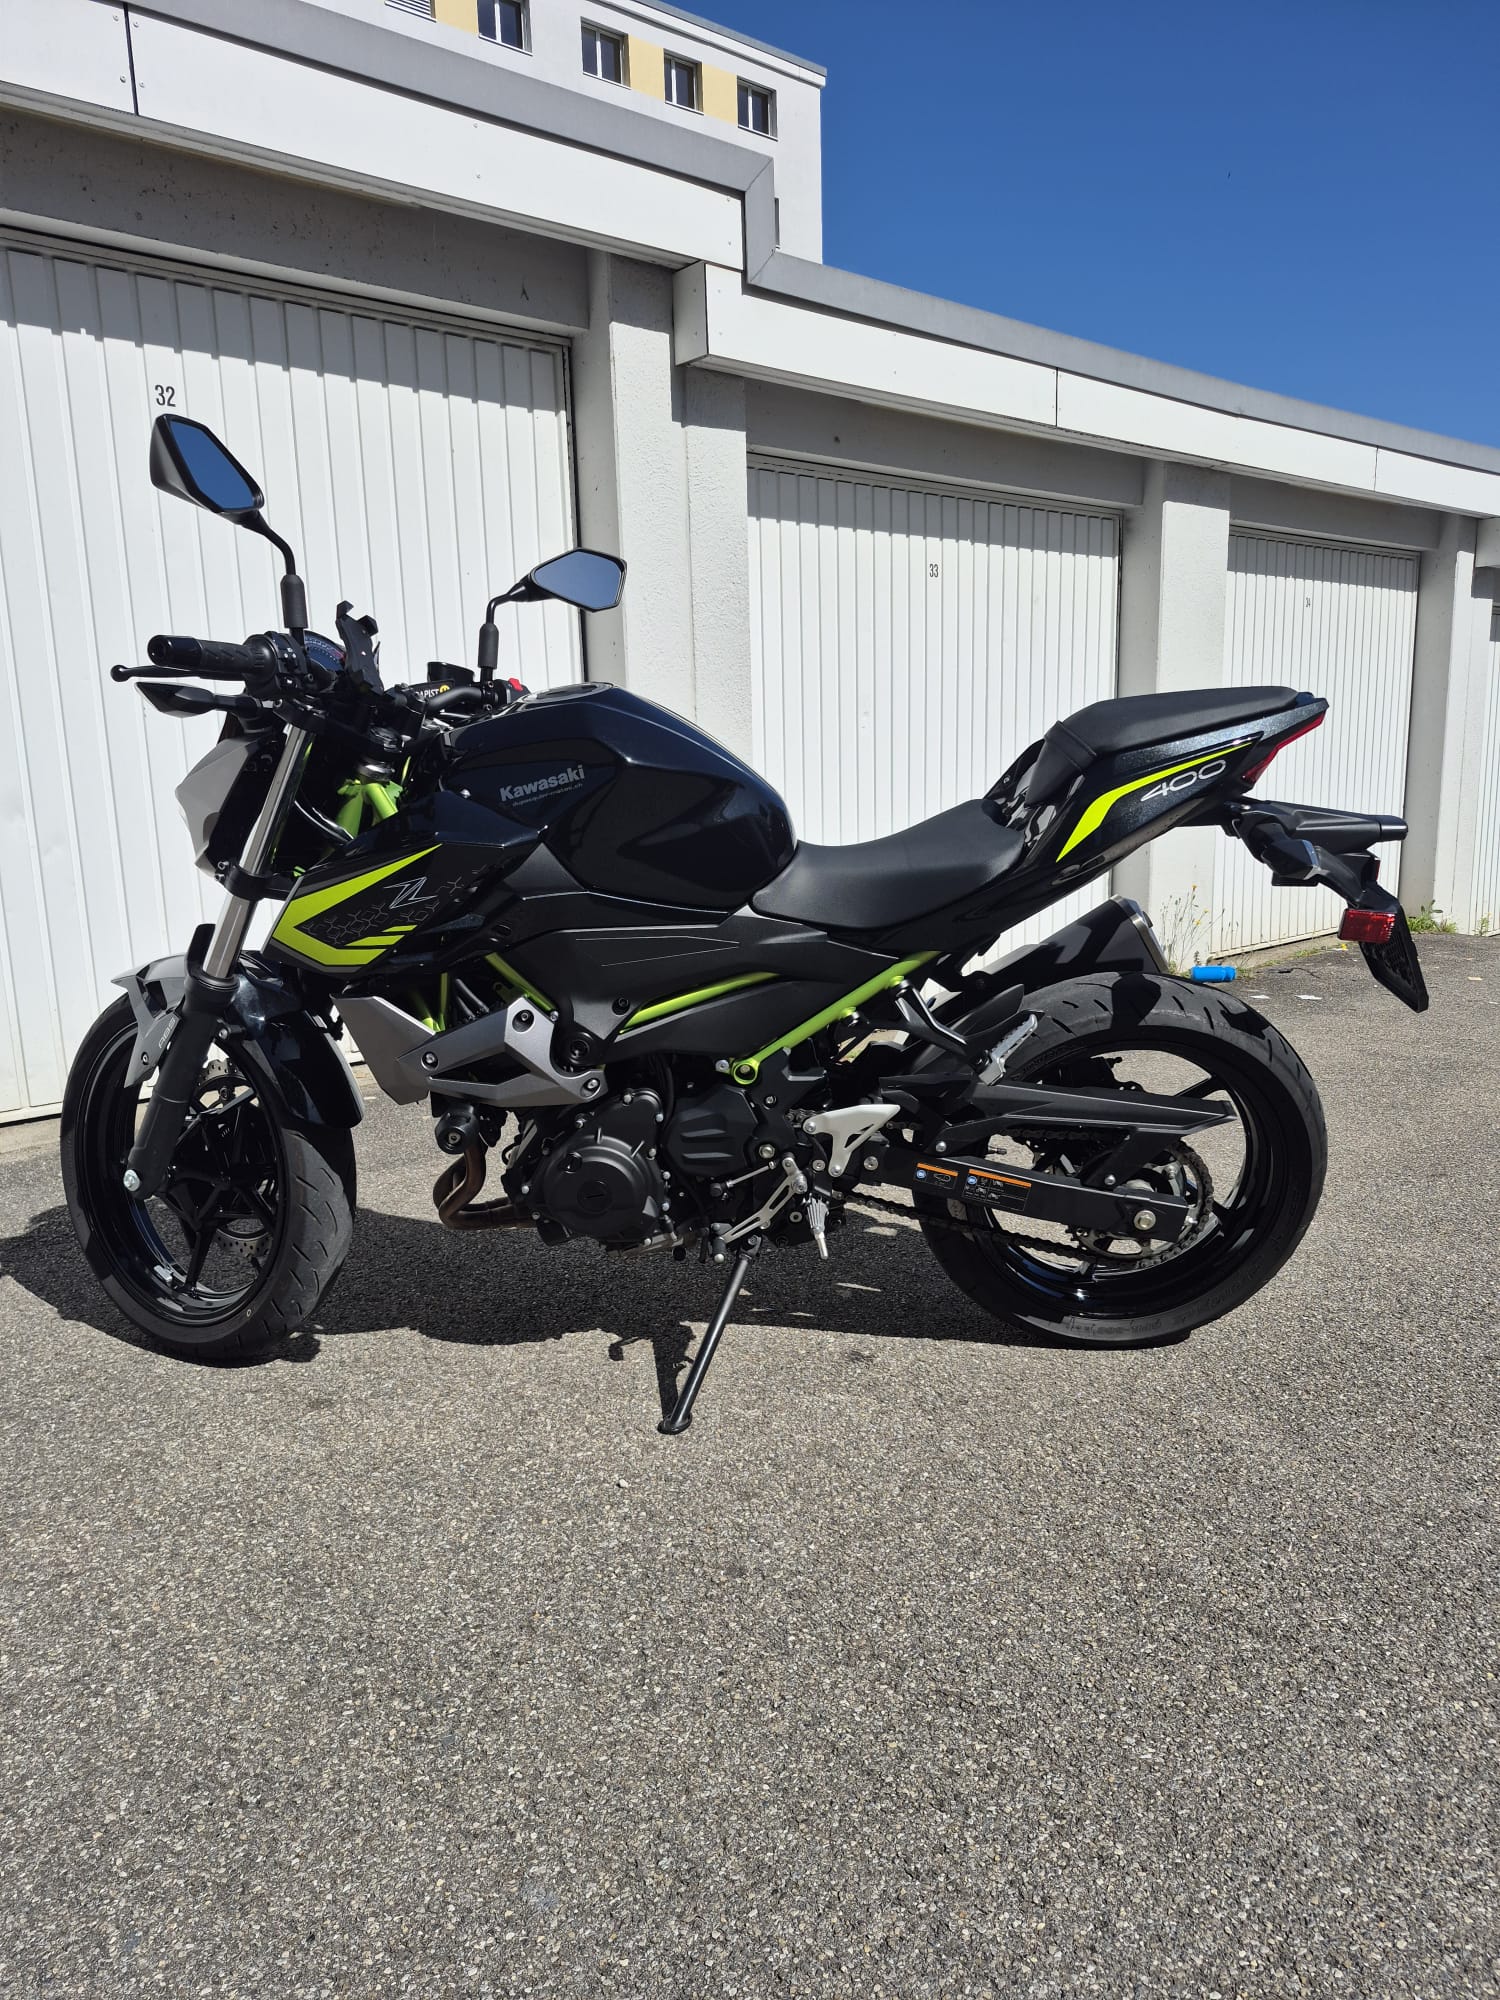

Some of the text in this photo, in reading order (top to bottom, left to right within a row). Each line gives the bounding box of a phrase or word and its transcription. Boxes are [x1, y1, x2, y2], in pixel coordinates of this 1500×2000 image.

[154, 384, 177, 408] 32
[929, 563, 939, 578] 33
[499, 764, 585, 802] Kawasaki
[1140, 759, 1227, 802] 400
[383, 876, 438, 910] Z
[158, 1017, 176, 1049] ABS
